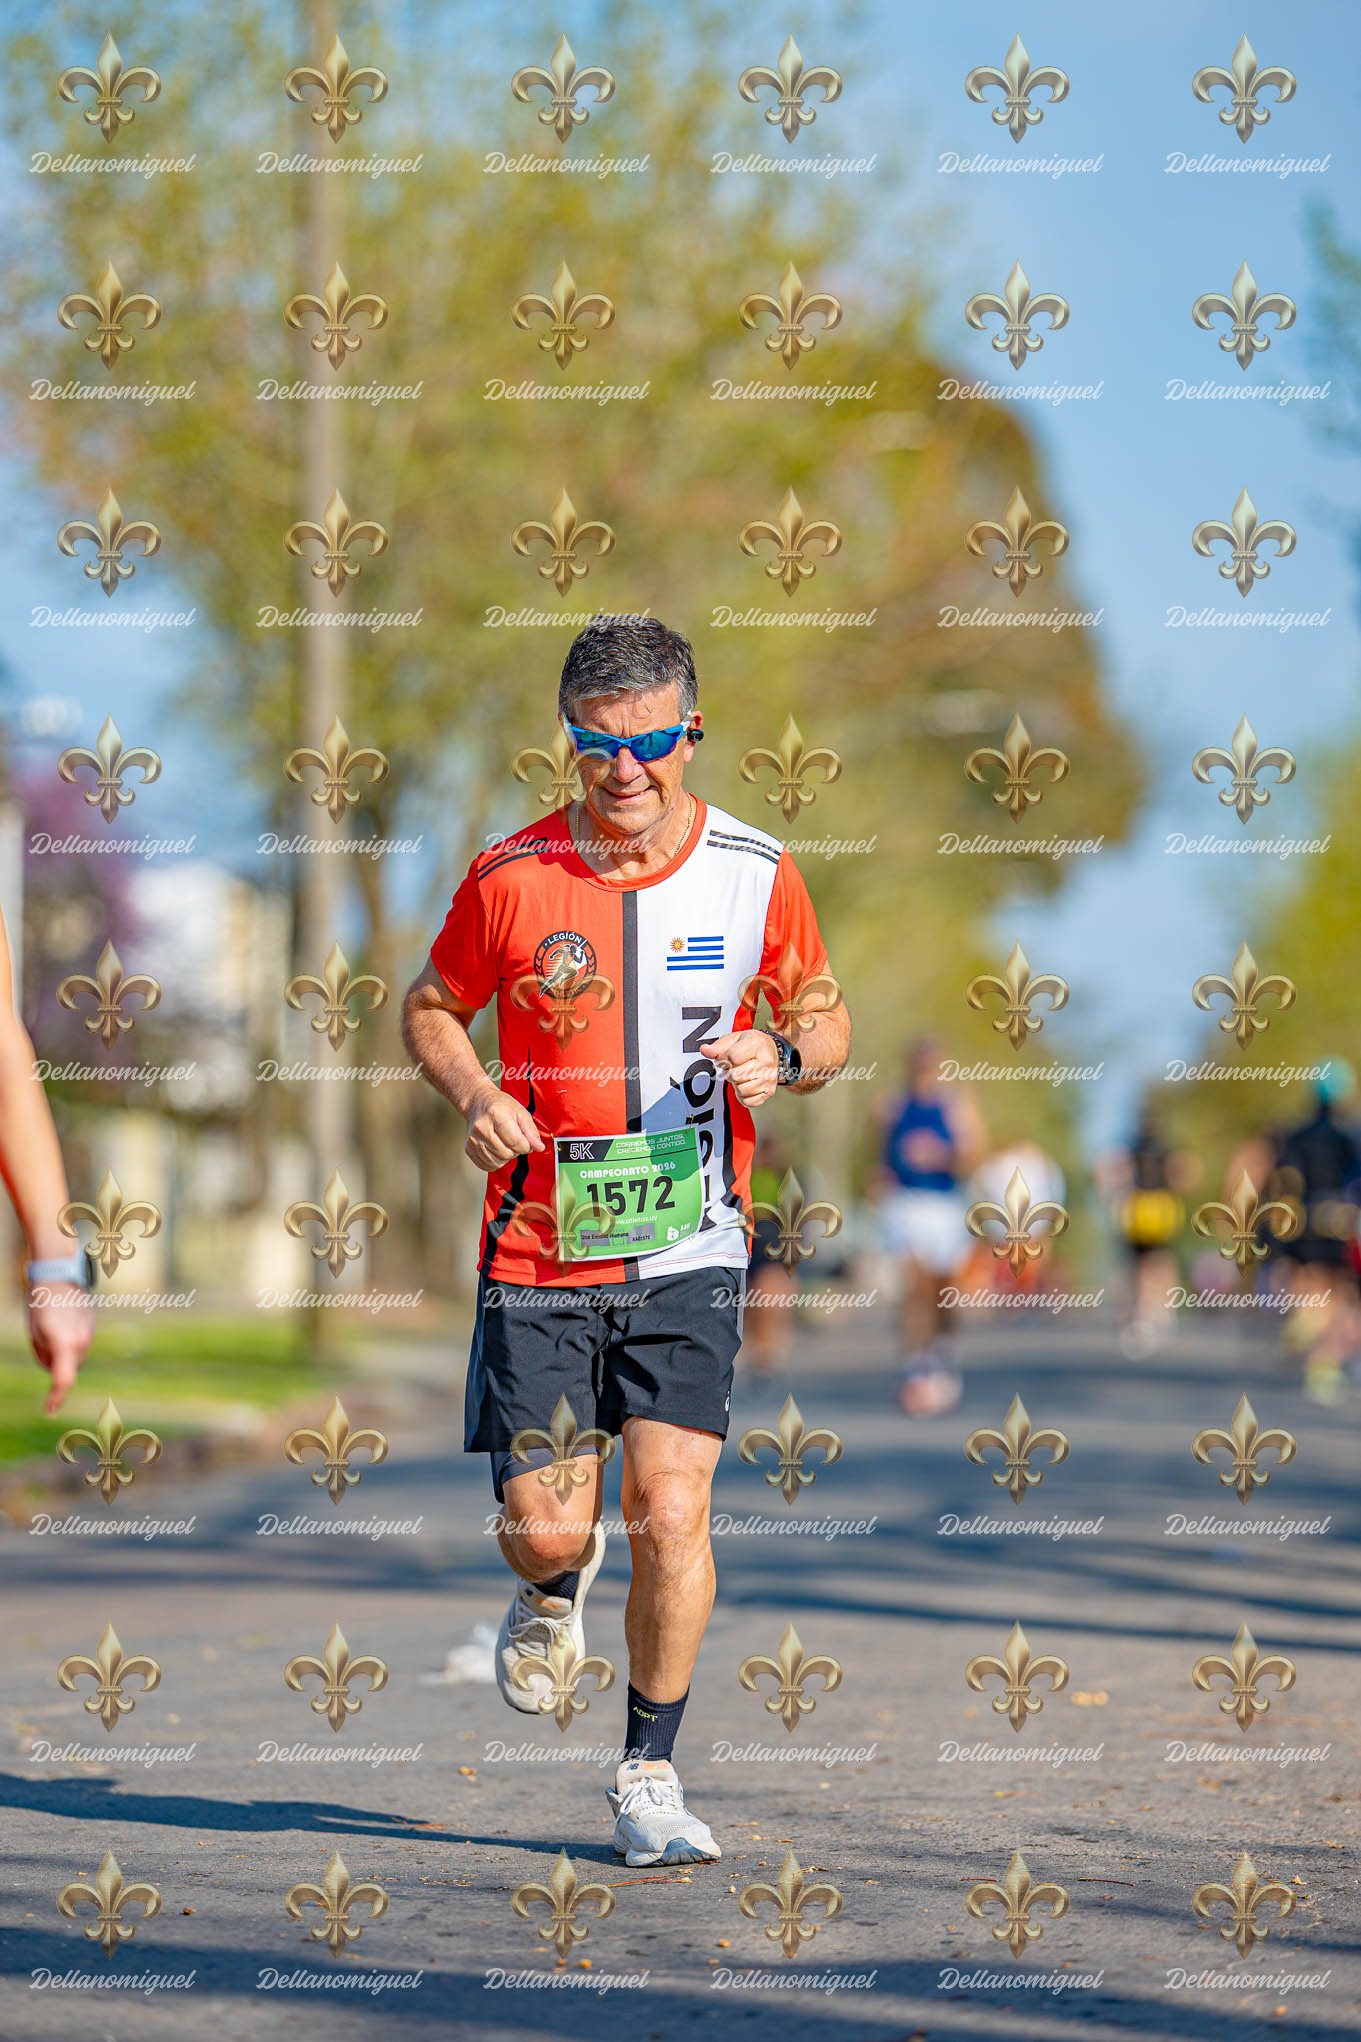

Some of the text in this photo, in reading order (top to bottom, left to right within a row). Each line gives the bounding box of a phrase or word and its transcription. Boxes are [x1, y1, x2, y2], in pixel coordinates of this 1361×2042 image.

[547, 931, 582, 945] LEGIÓN
[569, 1142, 595, 1160] 5K
[579, 1161, 676, 1179] CAMPEONATO 2026
[586, 1176, 675, 1217] 1572
